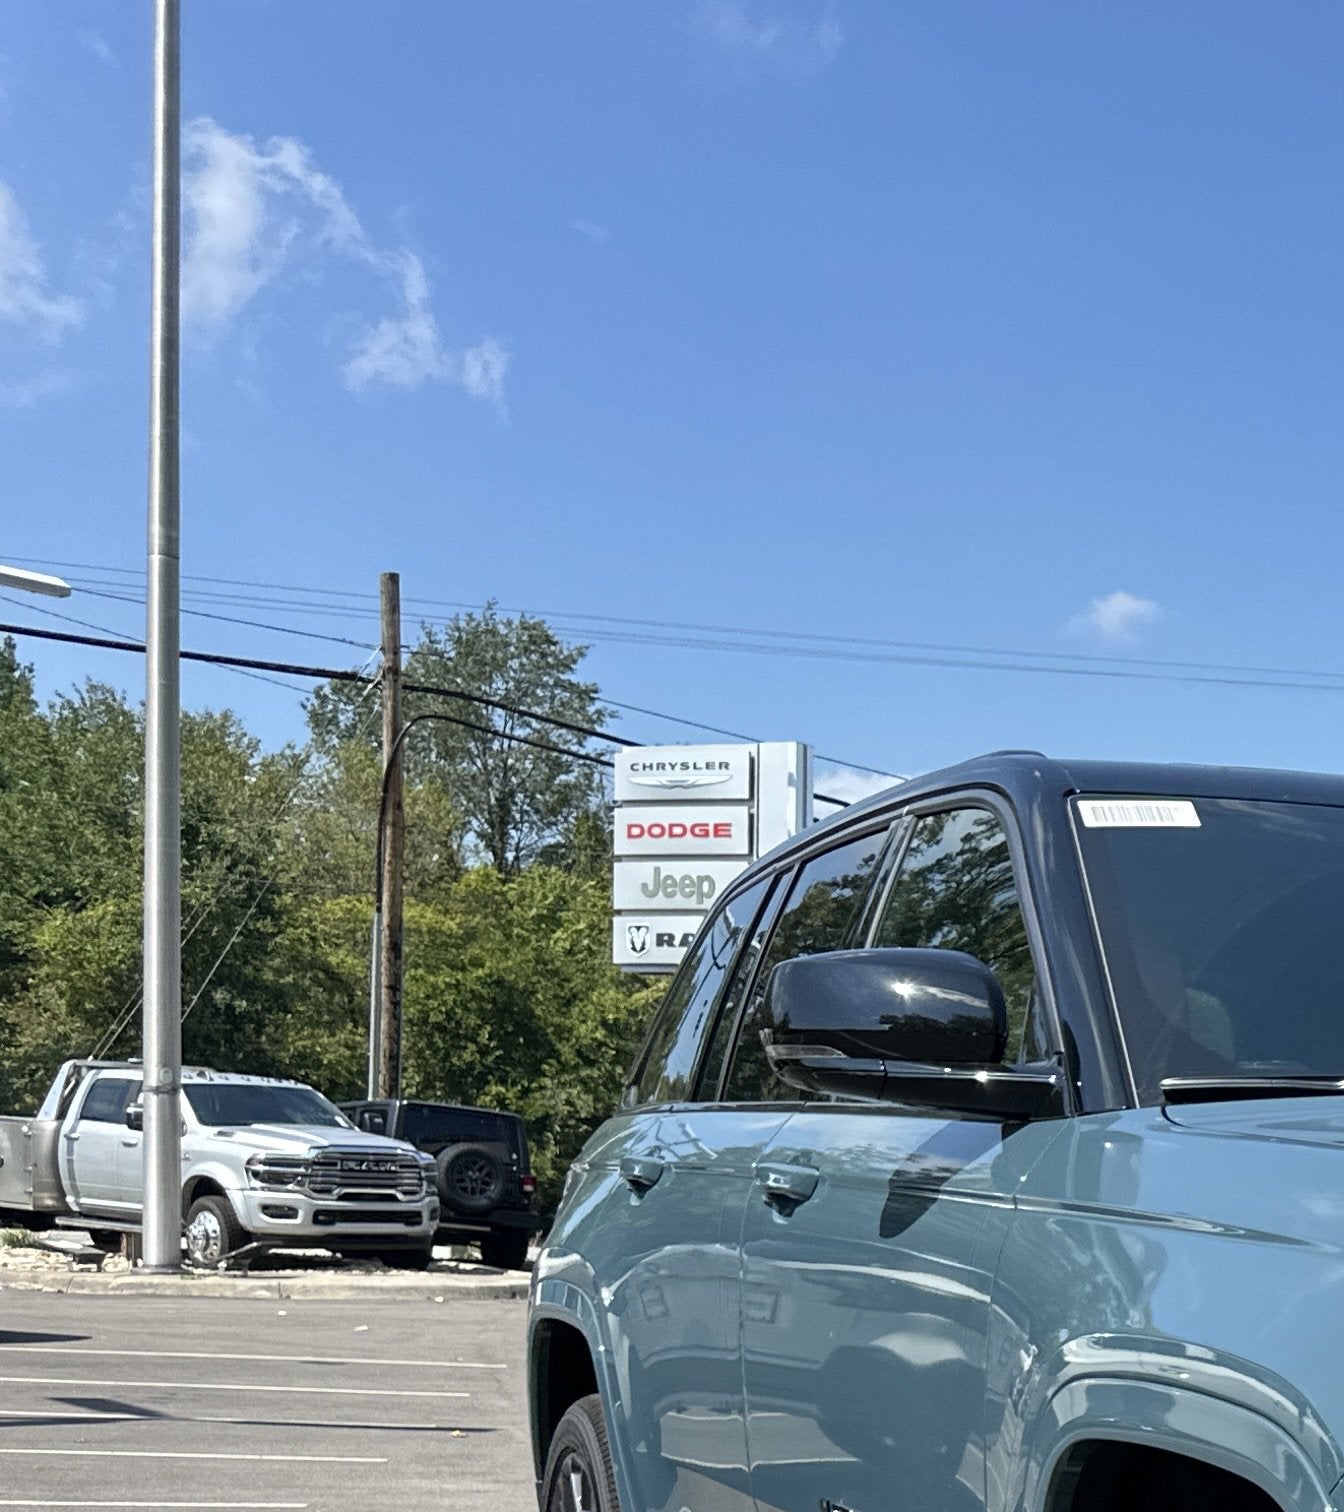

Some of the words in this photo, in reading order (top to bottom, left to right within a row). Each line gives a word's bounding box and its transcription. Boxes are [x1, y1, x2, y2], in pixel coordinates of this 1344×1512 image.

[629, 760, 731, 772] CHRYSLER
[626, 822, 733, 840] DODGE
[640, 866, 716, 905] Jeep
[655, 932, 699, 948] RA
